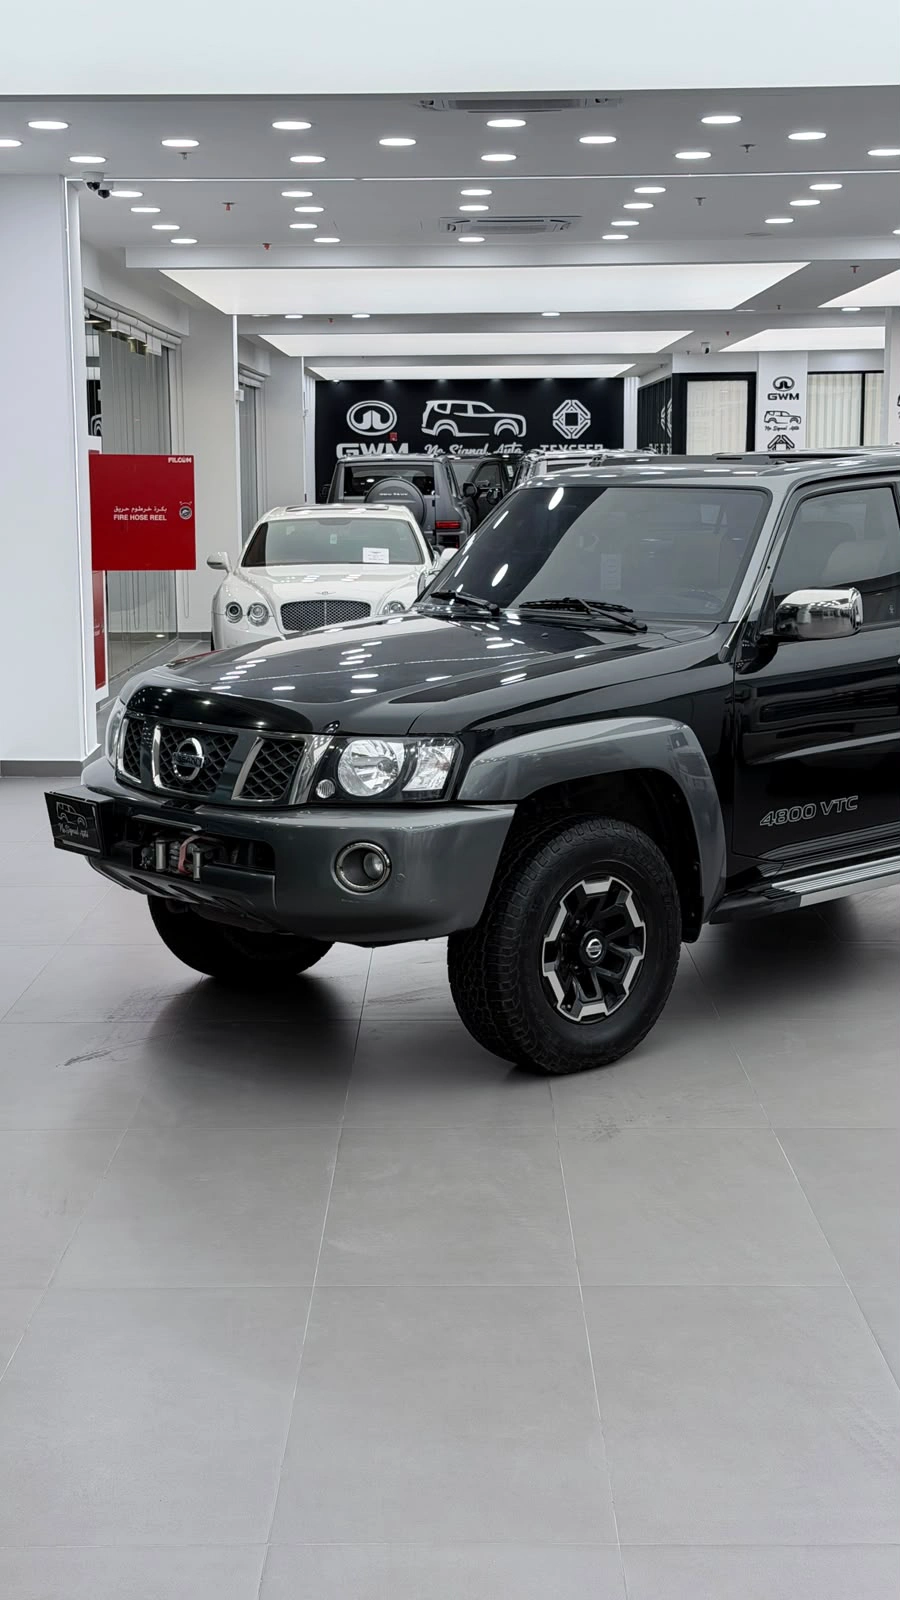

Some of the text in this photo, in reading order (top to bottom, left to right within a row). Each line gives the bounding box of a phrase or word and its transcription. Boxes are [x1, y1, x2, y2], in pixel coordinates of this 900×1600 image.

[768, 393, 800, 401] GWM
[336, 443, 409, 458] GWM
[759, 795, 859, 827] 4800 VTC
